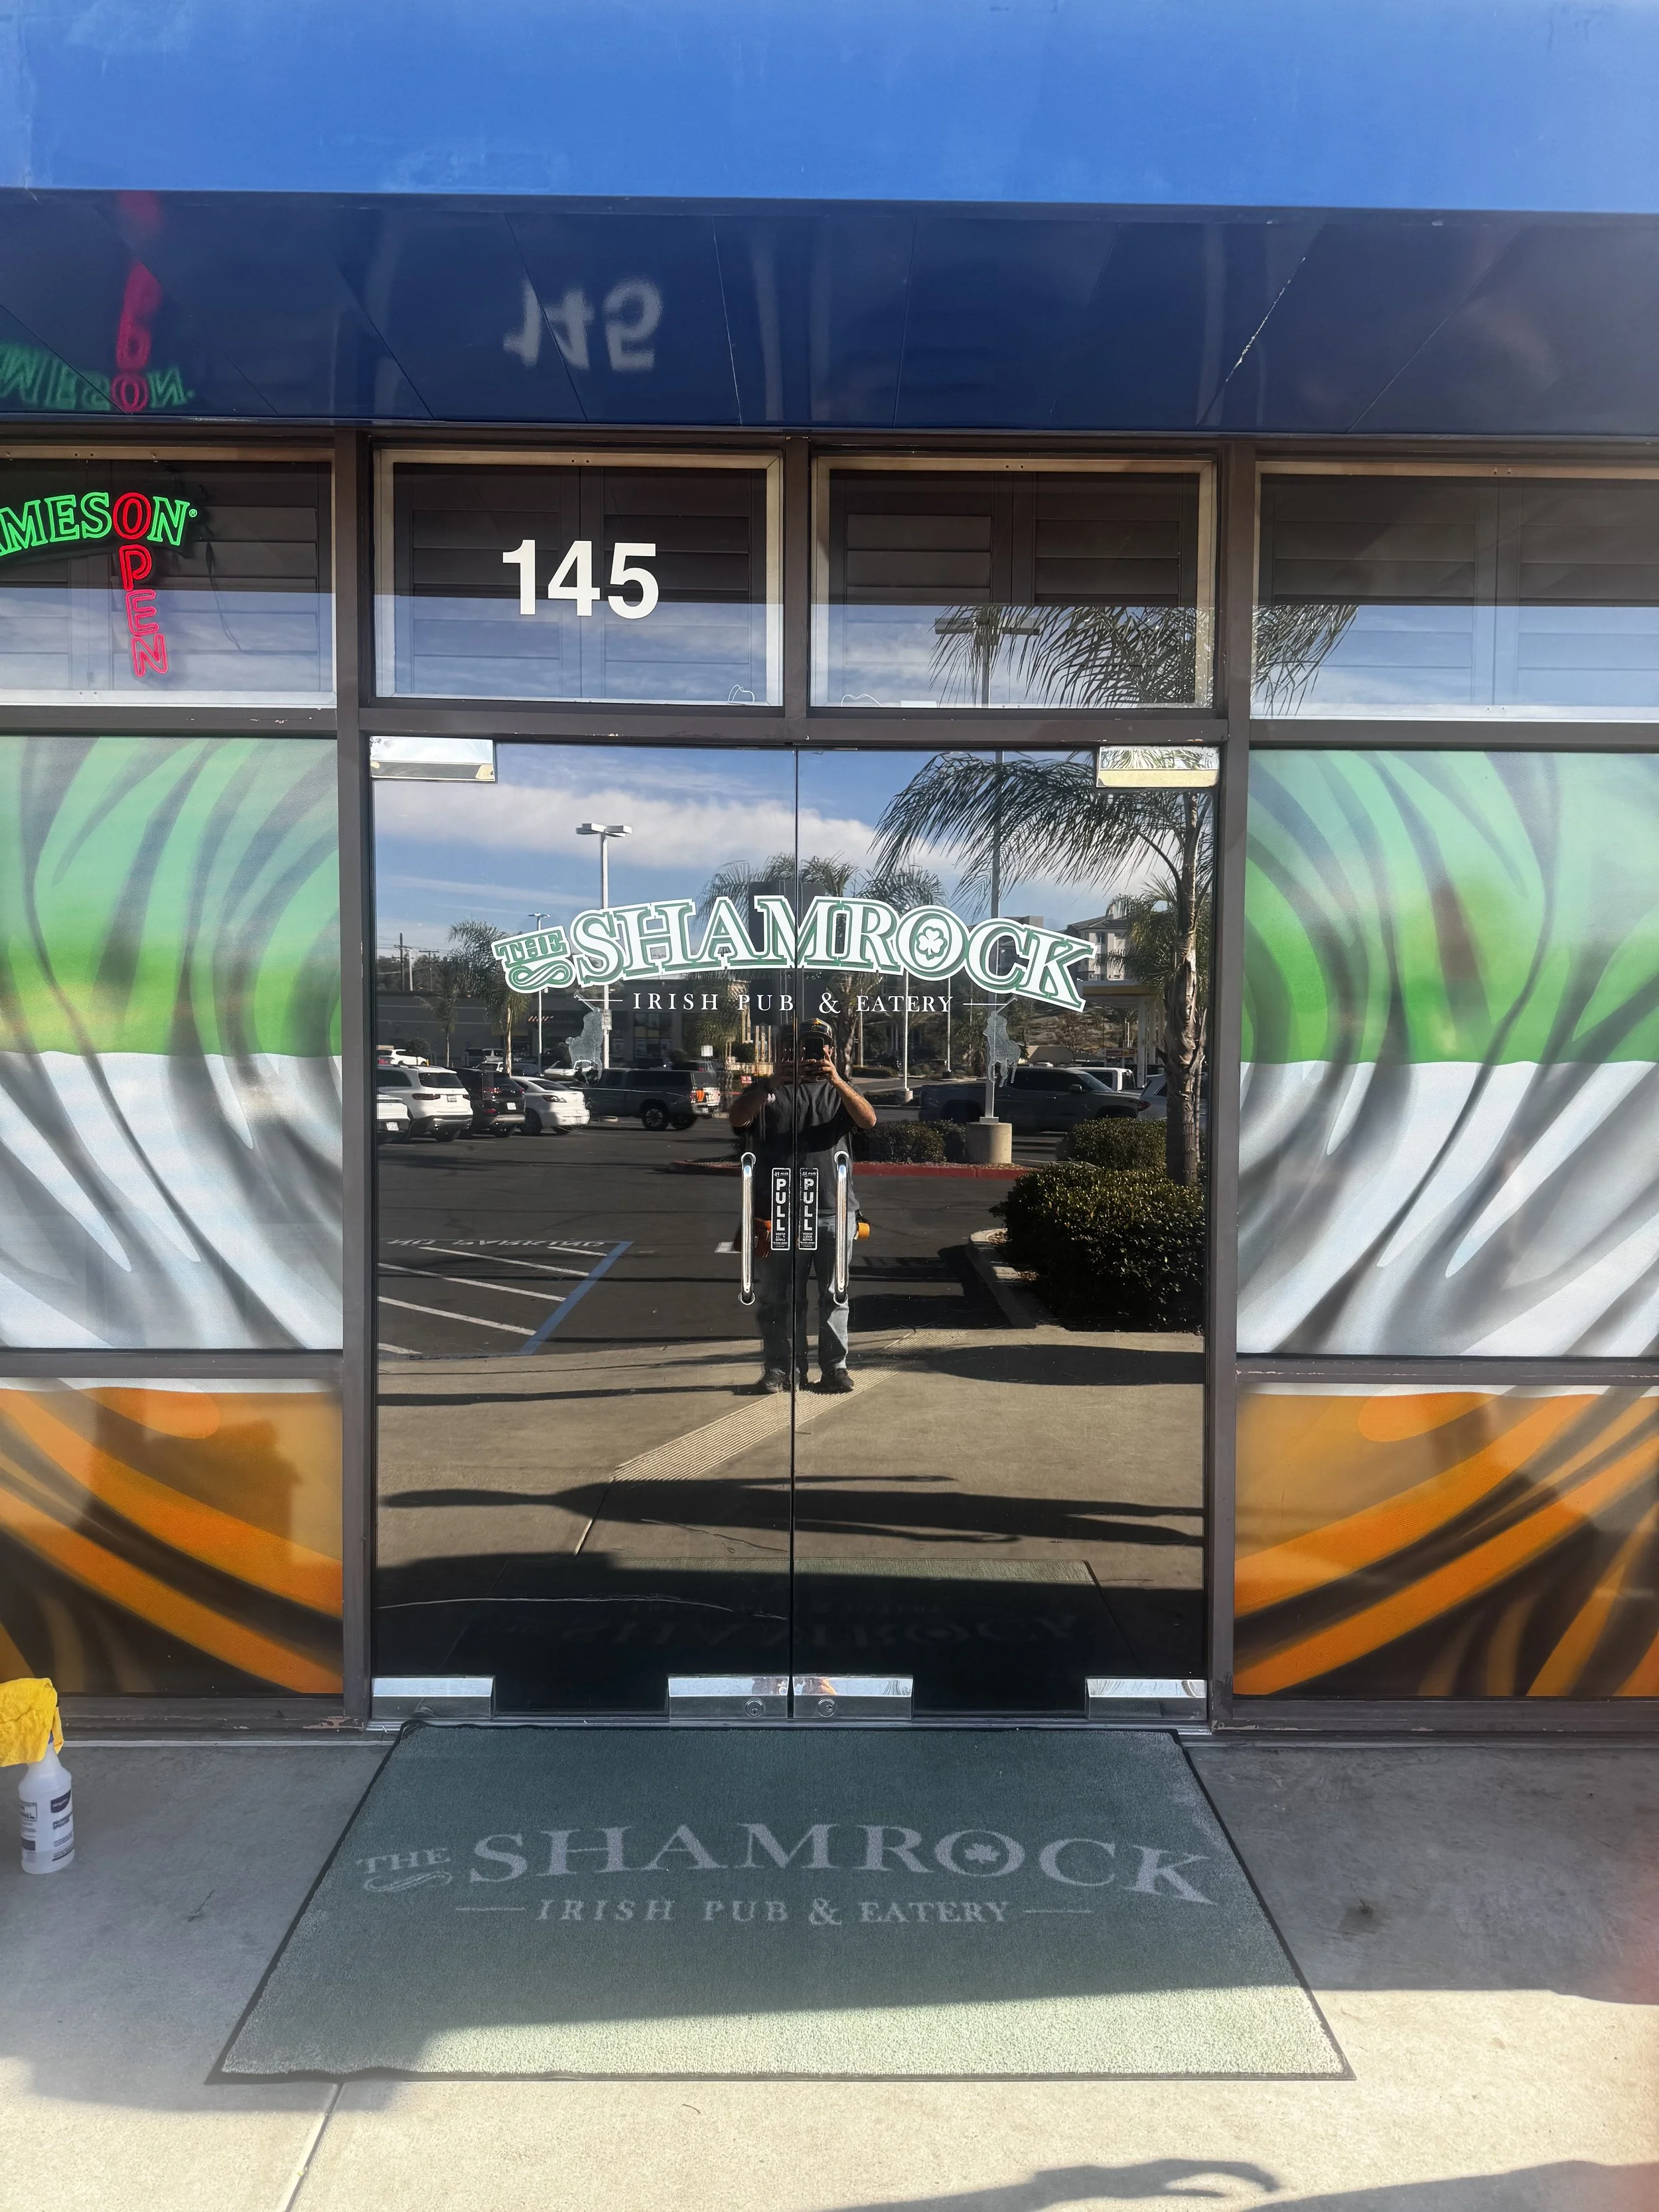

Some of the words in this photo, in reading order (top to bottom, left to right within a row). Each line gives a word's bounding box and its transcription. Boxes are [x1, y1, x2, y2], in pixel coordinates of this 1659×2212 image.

[113, 492, 169, 677] OPEN
[502, 539, 659, 619] 145
[495, 929, 569, 967] THE
[571, 896, 1096, 1012] SHAMROCK
[632, 992, 719, 1011] IRISH
[738, 994, 794, 1012] PUB
[818, 992, 841, 1014] &
[855, 995, 954, 1013] EATERY
[775, 1178, 787, 1231] PULL
[803, 1178, 814, 1231] PULL
[355, 1848, 452, 1875] THE
[469, 1823, 1219, 1906] SHAMROCK
[535, 1899, 676, 1921] IRISH
[703, 1900, 788, 1922] PUB
[807, 1897, 843, 1925] &
[861, 1901, 1010, 1923] EATERY
